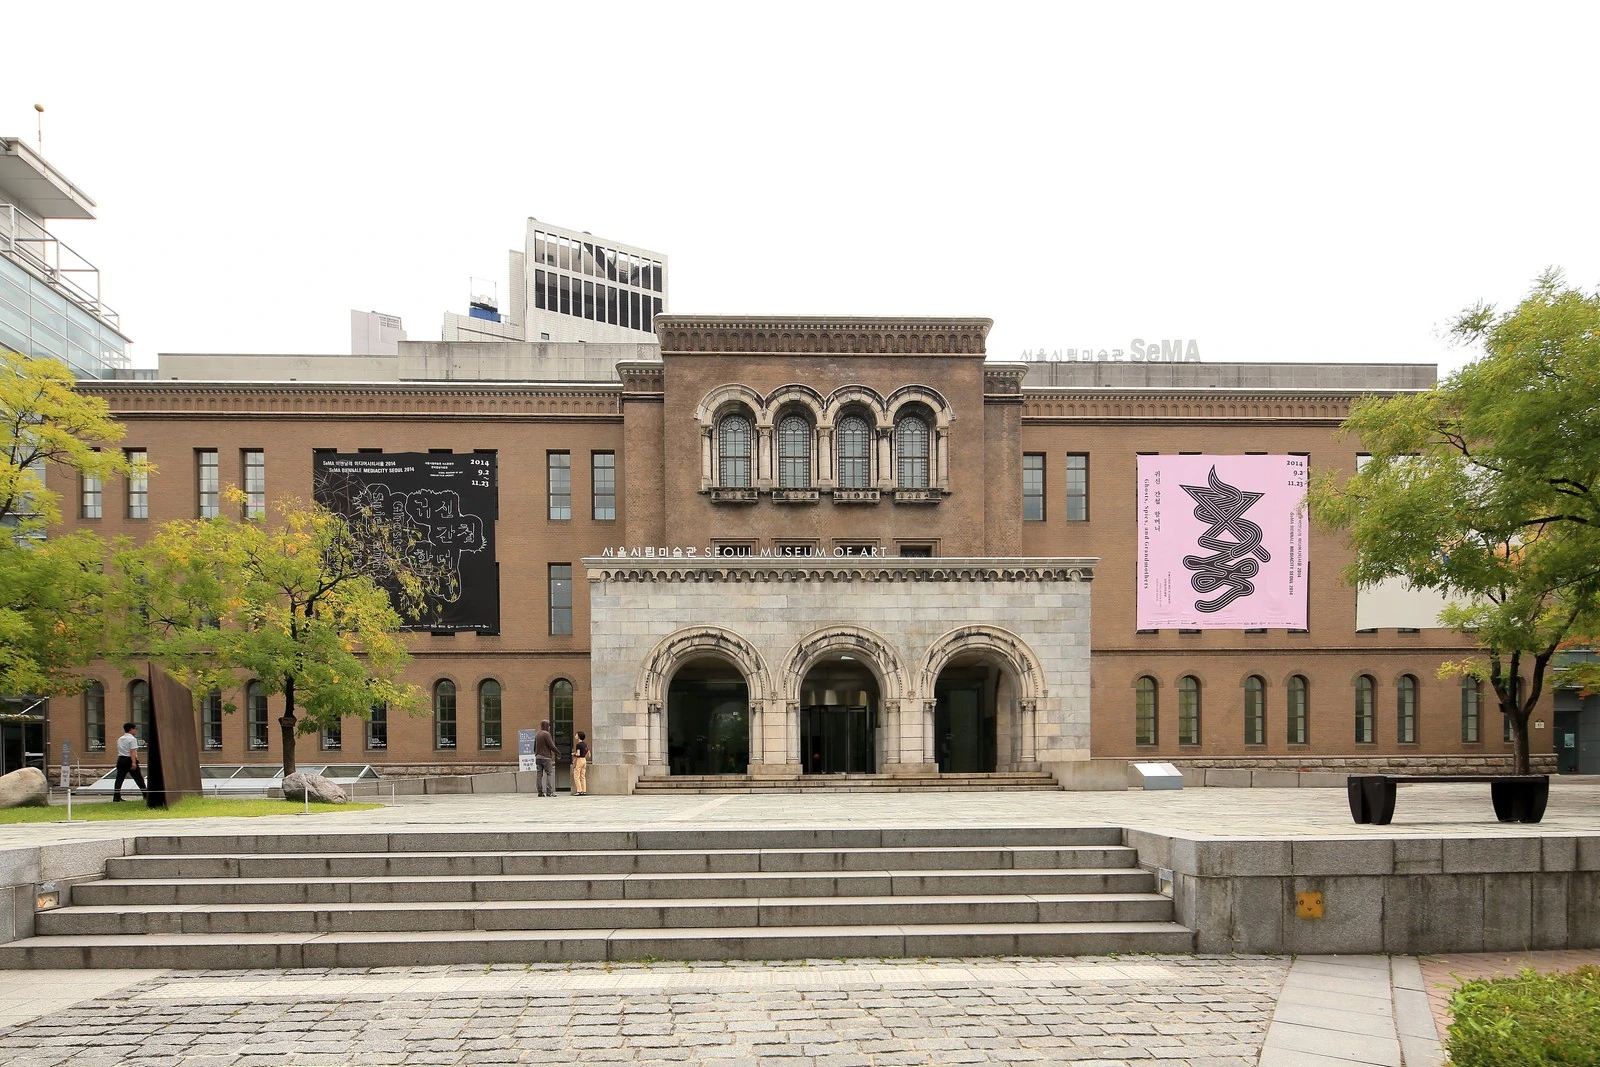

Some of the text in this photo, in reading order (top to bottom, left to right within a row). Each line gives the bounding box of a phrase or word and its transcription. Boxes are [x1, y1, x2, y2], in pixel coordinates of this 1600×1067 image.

[1020, 338, 1201, 362] 서울시립미술관 SeMA
[470, 459, 489, 467] 2014
[471, 480, 489, 488] 11.23
[1287, 480, 1303, 488] 11.23
[601, 546, 887, 558] 서울시립미술관 SEOUL MUSEUM OF ART
